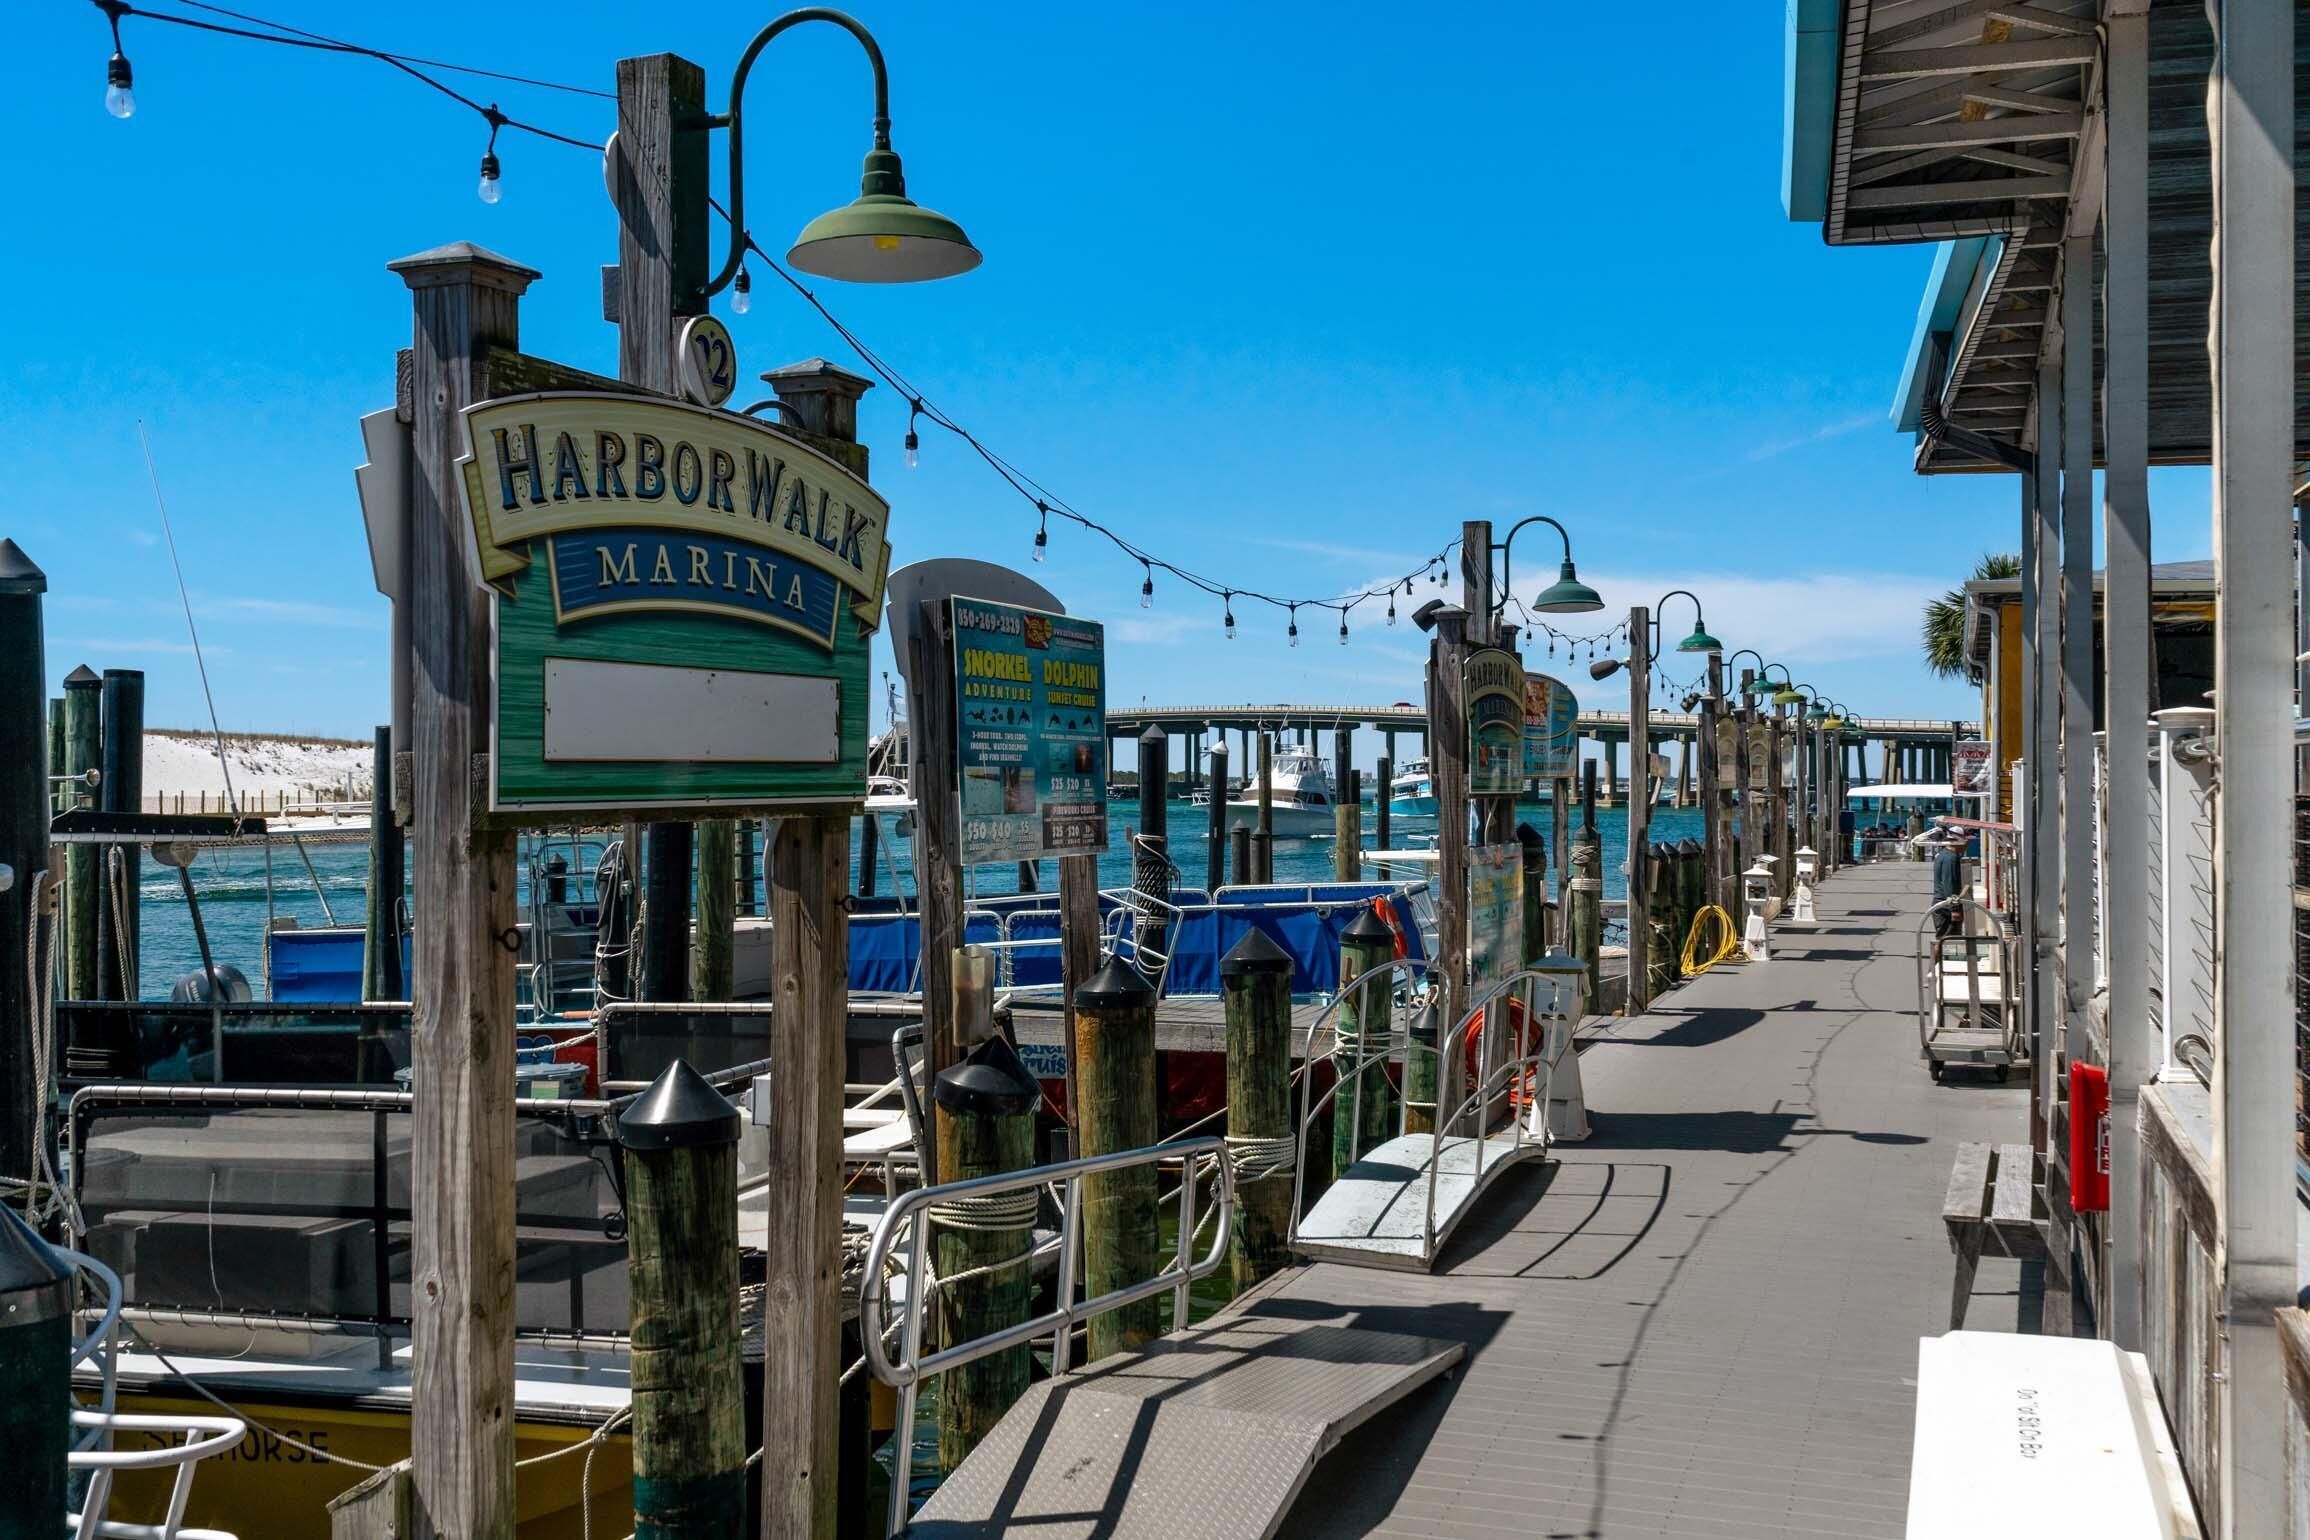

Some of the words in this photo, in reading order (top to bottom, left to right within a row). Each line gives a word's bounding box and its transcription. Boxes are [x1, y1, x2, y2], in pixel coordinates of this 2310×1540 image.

[489, 423, 872, 573] HARBORWALK
[597, 542, 807, 614] MARINA
[964, 648, 1032, 682] SNORKEL
[1043, 659, 1099, 689] DOLPHIN
[965, 682, 1032, 701] ADVENTURE
[1048, 690, 1072, 705] SUNSET
[1073, 693, 1097, 707] CRUISE
